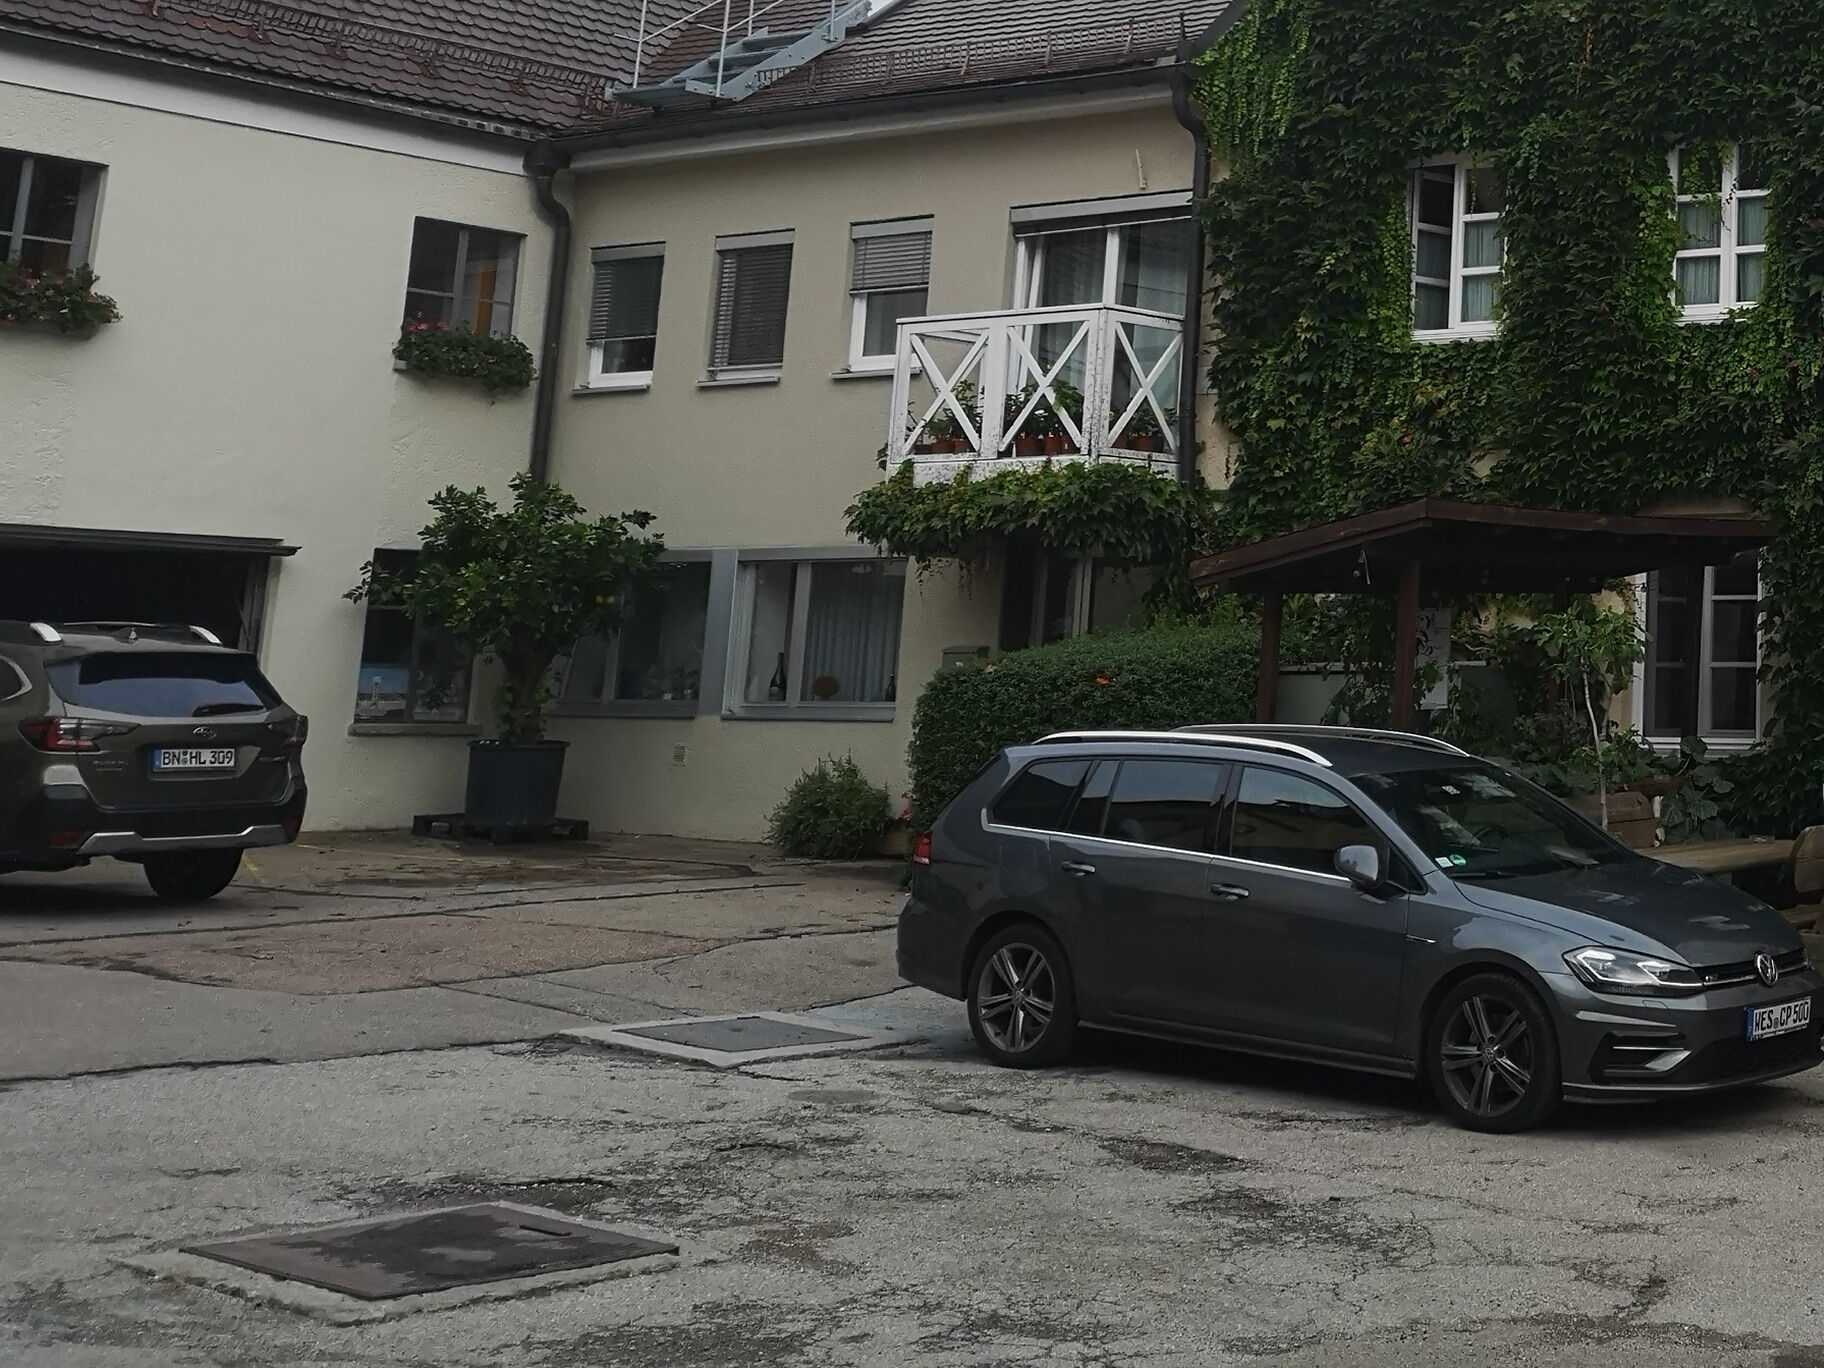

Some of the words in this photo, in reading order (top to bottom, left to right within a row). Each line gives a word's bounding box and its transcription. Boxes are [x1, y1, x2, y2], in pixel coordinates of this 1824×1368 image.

[162, 751, 181, 765] BN
[189, 751, 206, 765] HL
[209, 750, 233, 764] 309
[1754, 1009, 1774, 1033] WES
[1779, 1005, 1792, 1027] CP
